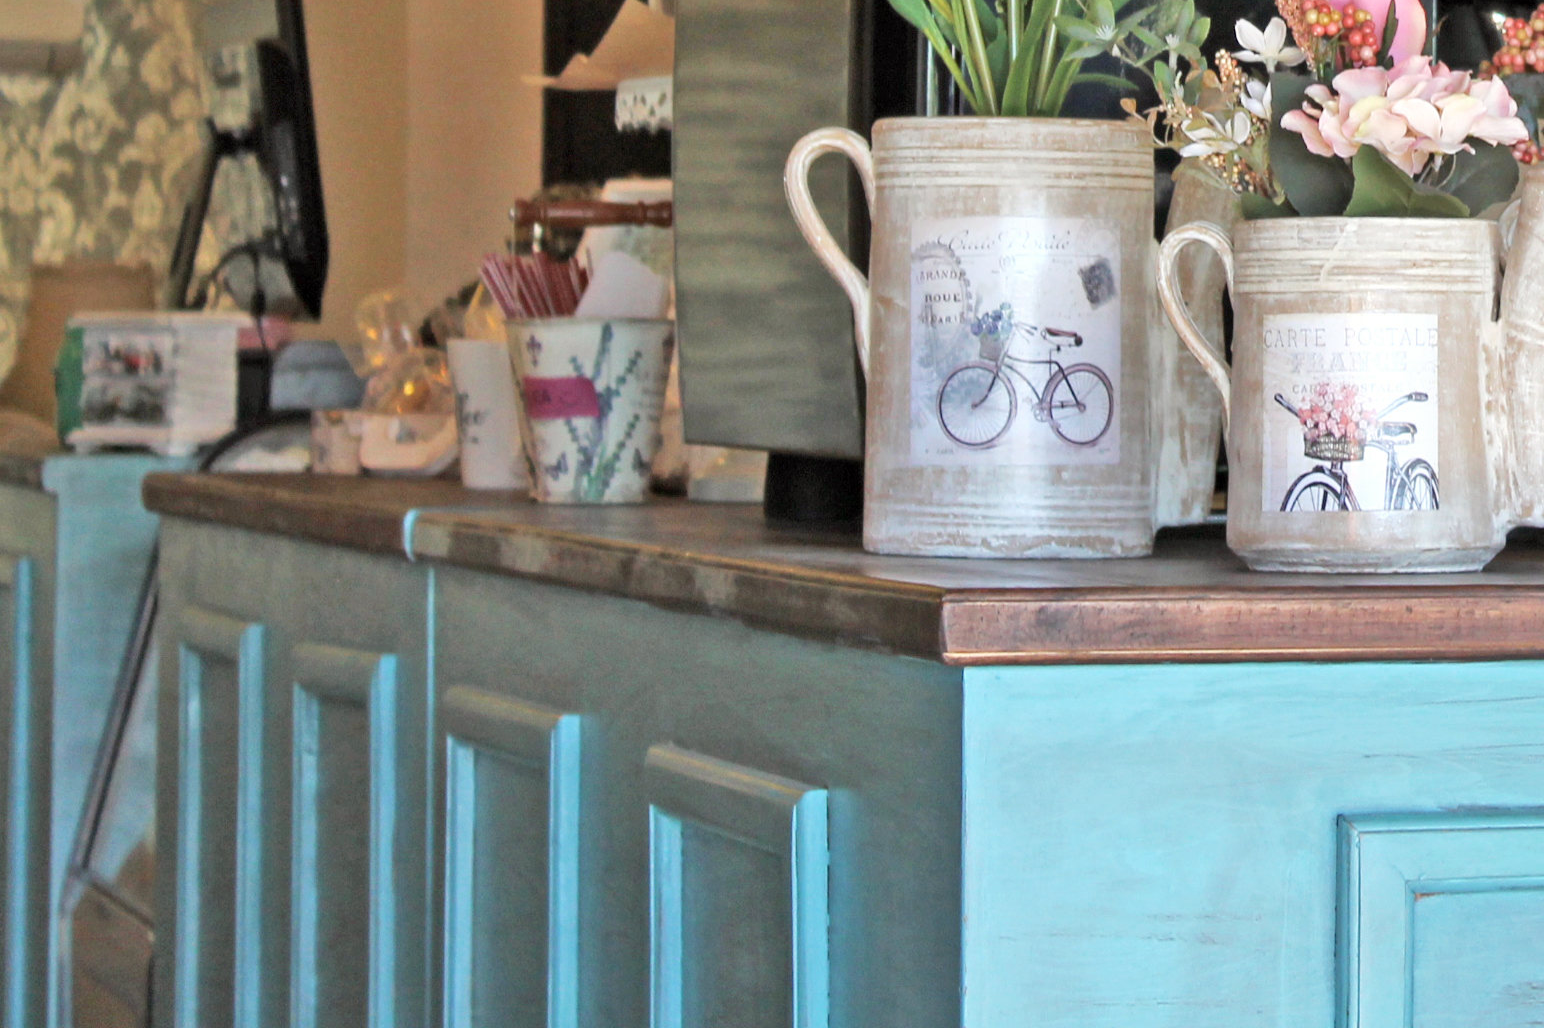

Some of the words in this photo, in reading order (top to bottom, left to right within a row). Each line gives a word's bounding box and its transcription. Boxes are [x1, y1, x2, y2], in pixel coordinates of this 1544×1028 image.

[1263, 327, 1327, 349] CARTE
[1344, 327, 1438, 347] POSTALE
[1290, 351, 1408, 374] FRANCE
